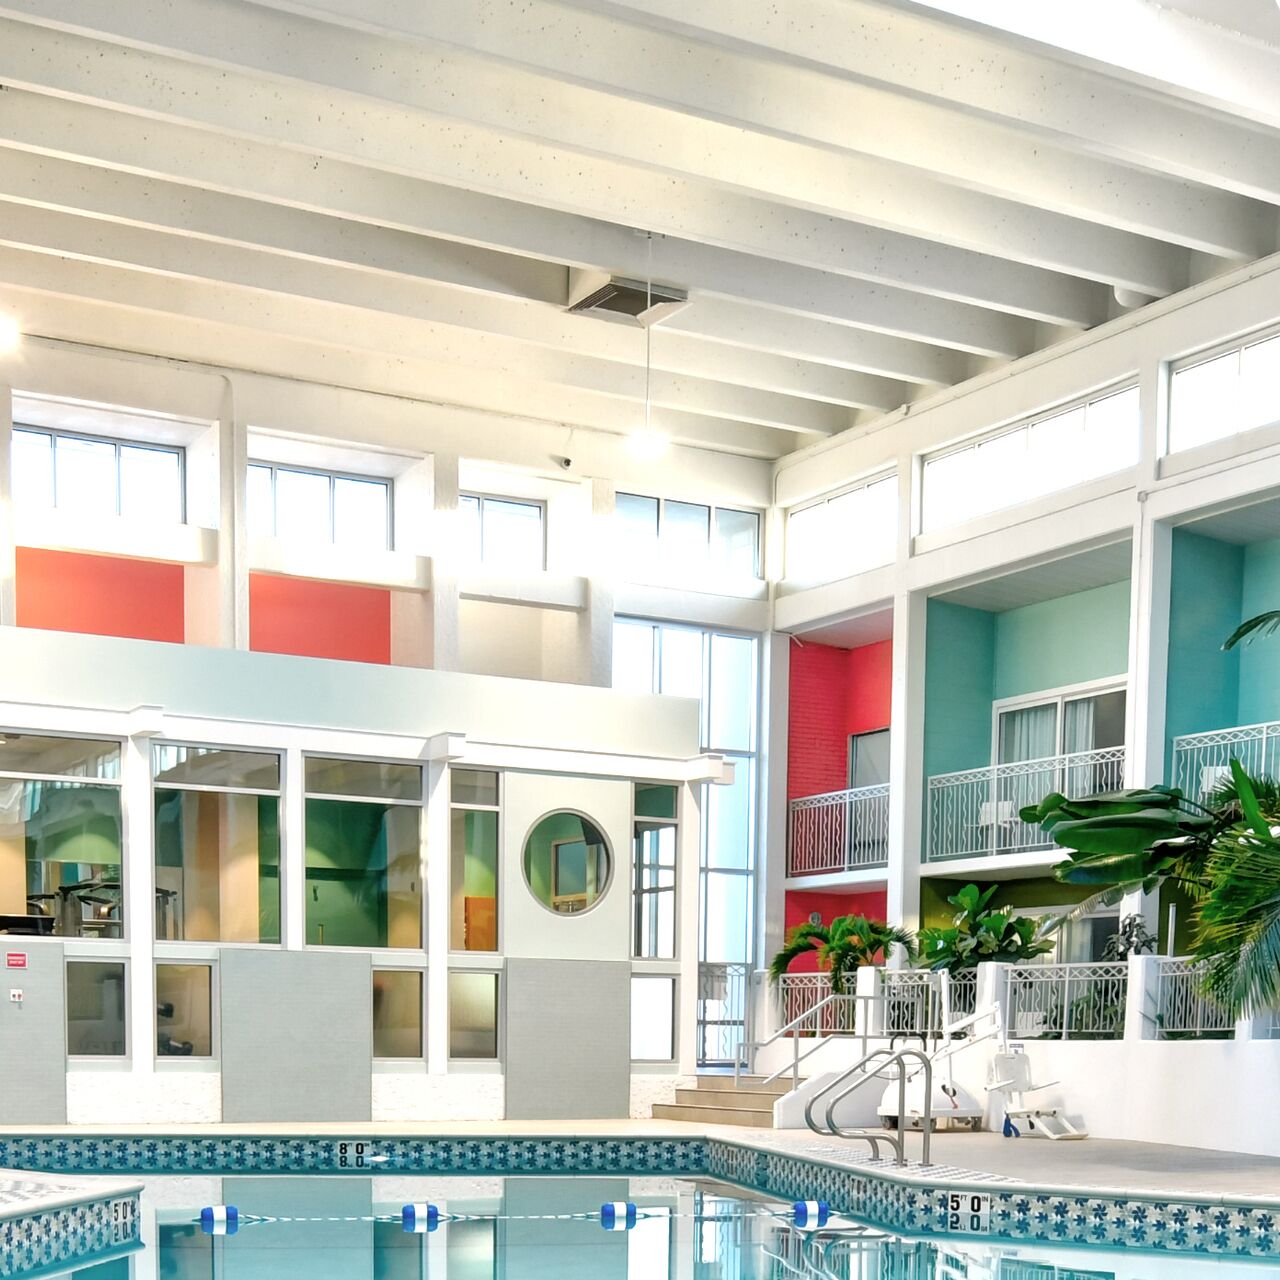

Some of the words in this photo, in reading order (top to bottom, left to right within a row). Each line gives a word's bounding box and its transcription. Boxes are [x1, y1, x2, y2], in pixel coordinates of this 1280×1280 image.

[340, 1142, 348, 1155] 8
[356, 1142, 364, 1155] 0
[950, 1194, 960, 1211] 5
[971, 1196, 981, 1213] 0
